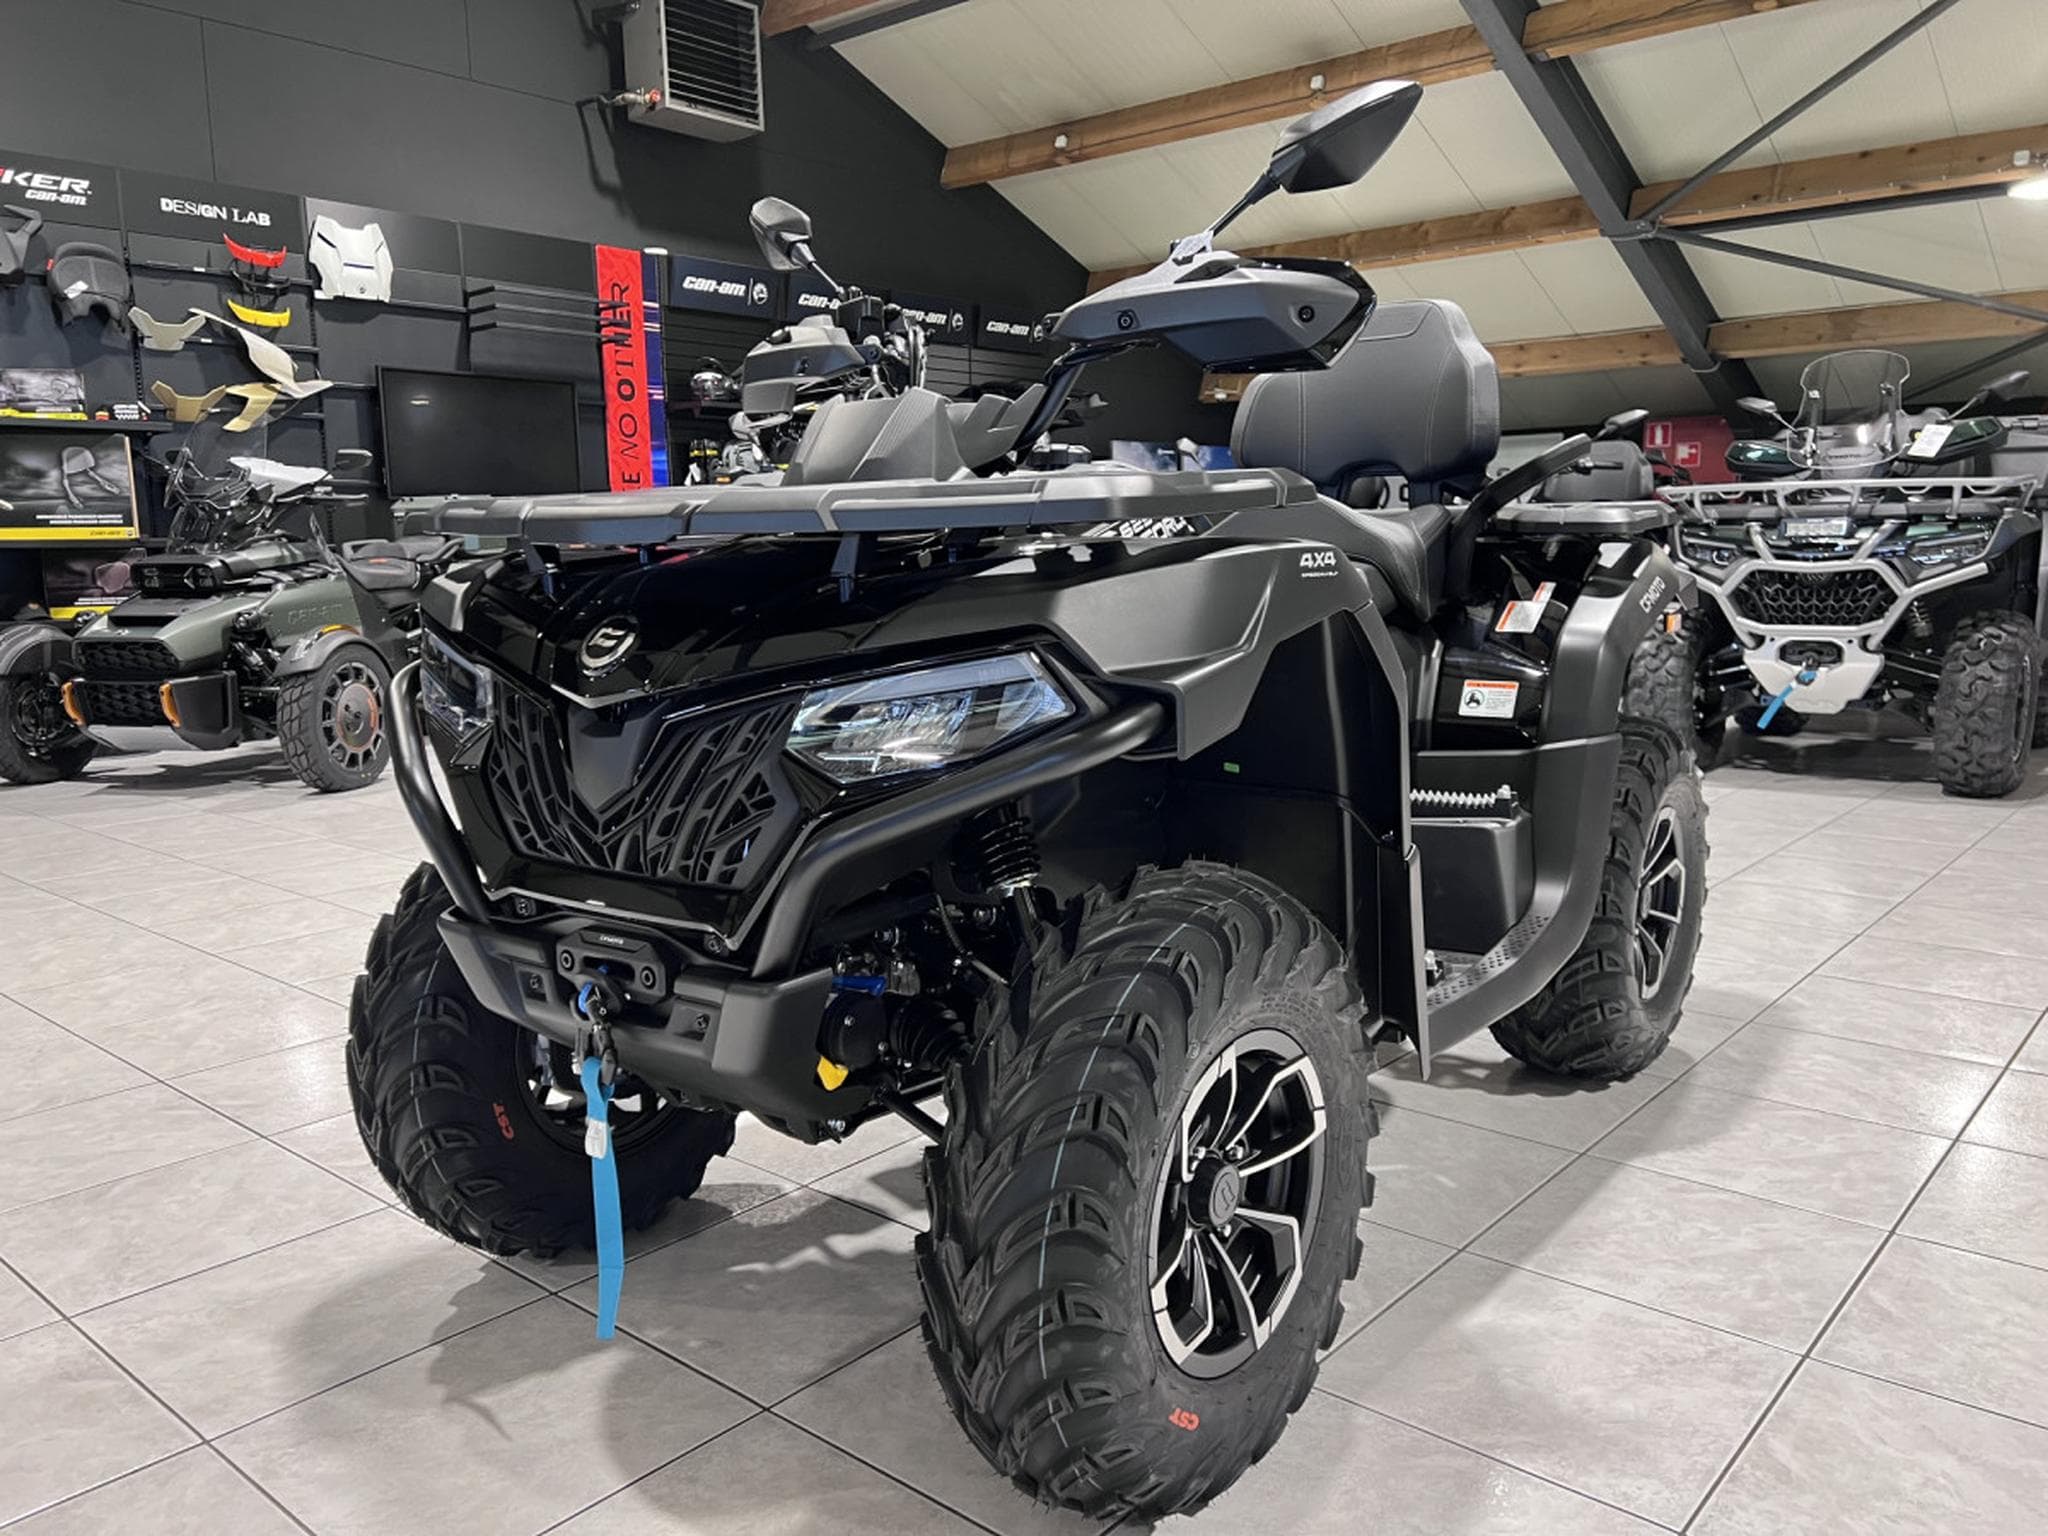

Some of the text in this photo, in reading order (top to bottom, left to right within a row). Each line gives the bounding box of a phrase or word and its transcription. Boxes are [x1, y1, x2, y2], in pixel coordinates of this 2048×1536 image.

[160, 197, 271, 226] DESIGN LAB
[682, 275, 747, 297] can-am
[798, 293, 841, 310] can-a
[986, 320, 1030, 336] can-am
[610, 281, 637, 403] OTHER
[619, 413, 640, 461] NO
[1299, 552, 1337, 568] 4X4
[1639, 575, 1666, 614] CFMOTO
[1168, 1406, 1200, 1432] CST
